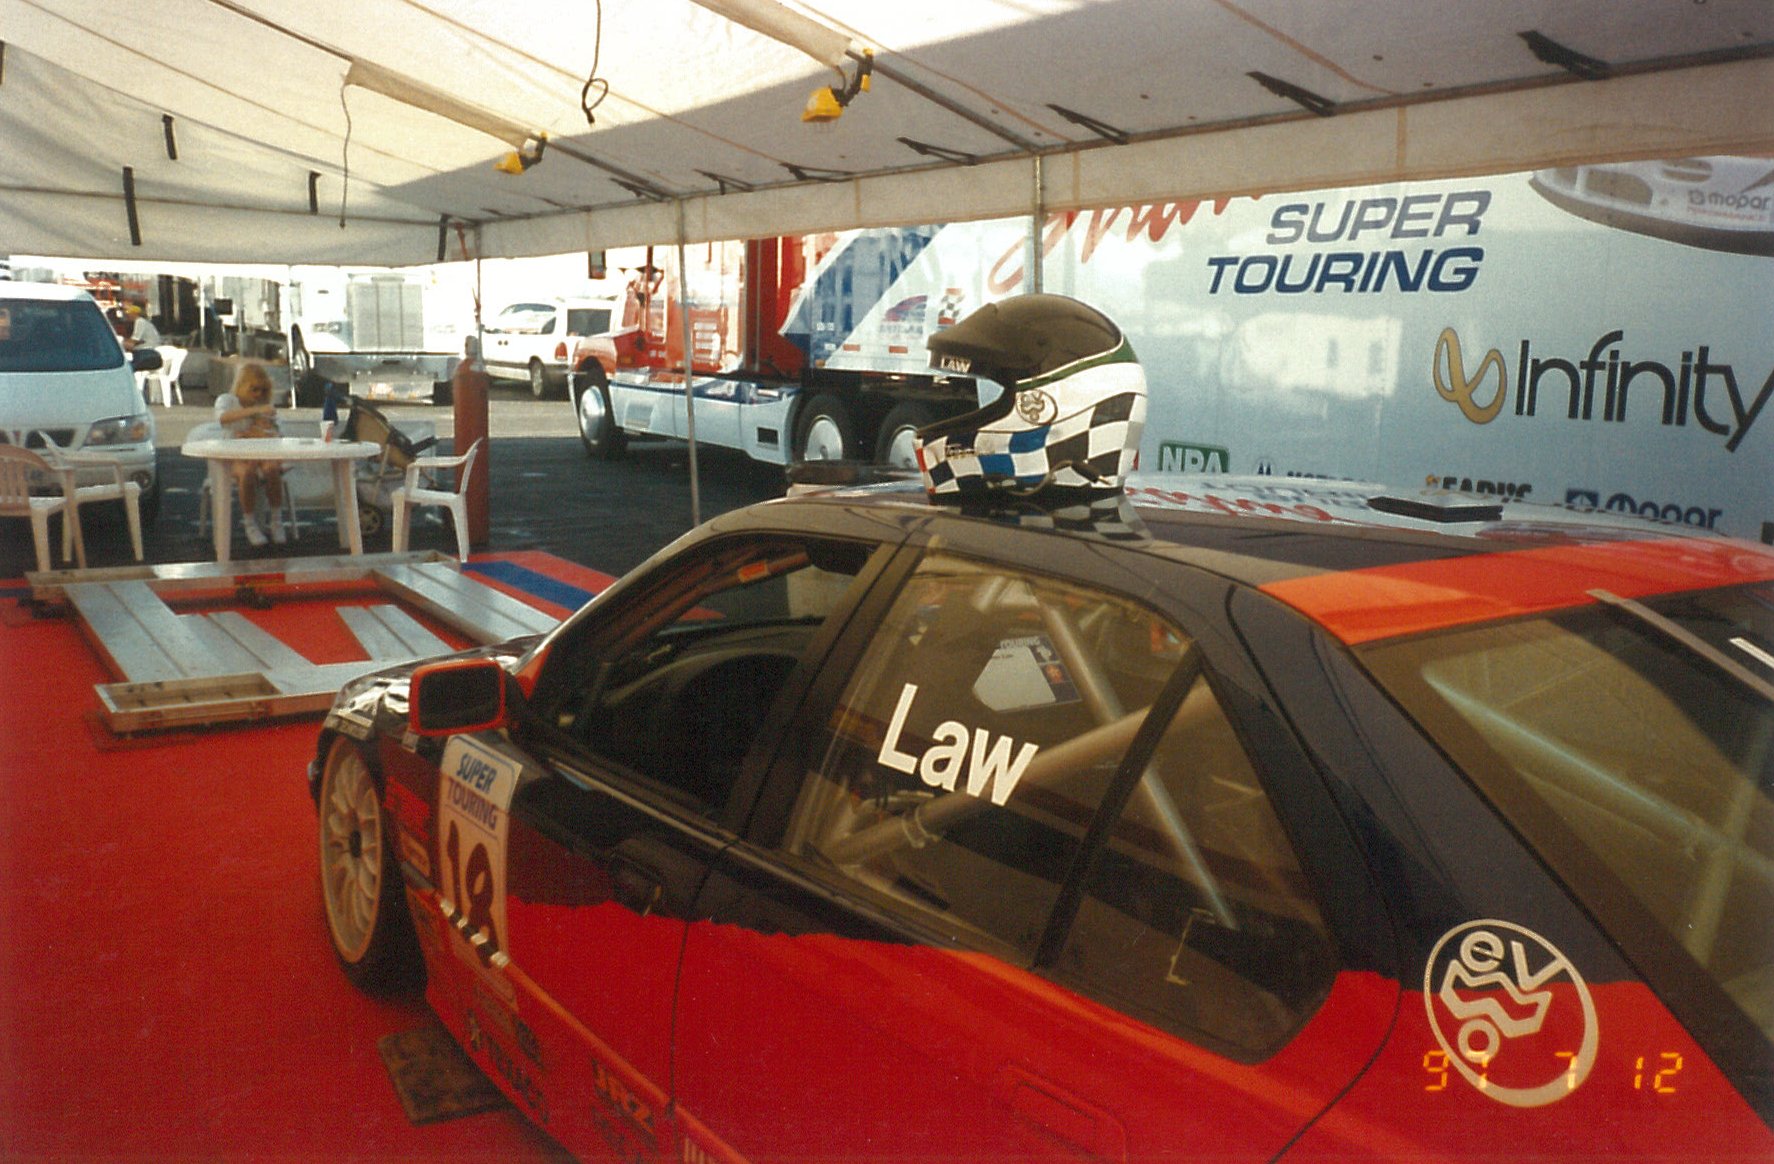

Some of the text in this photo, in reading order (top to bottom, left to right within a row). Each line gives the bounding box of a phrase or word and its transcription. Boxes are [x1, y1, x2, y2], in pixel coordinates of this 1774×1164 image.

[1266, 190, 1492, 246] SUPER
[1207, 247, 1485, 294] TOURING
[1515, 329, 1774, 452] Infinity
[877, 682, 1039, 807] Law
[456, 753, 497, 794] SUPER
[448, 776, 498, 831] TOURING
